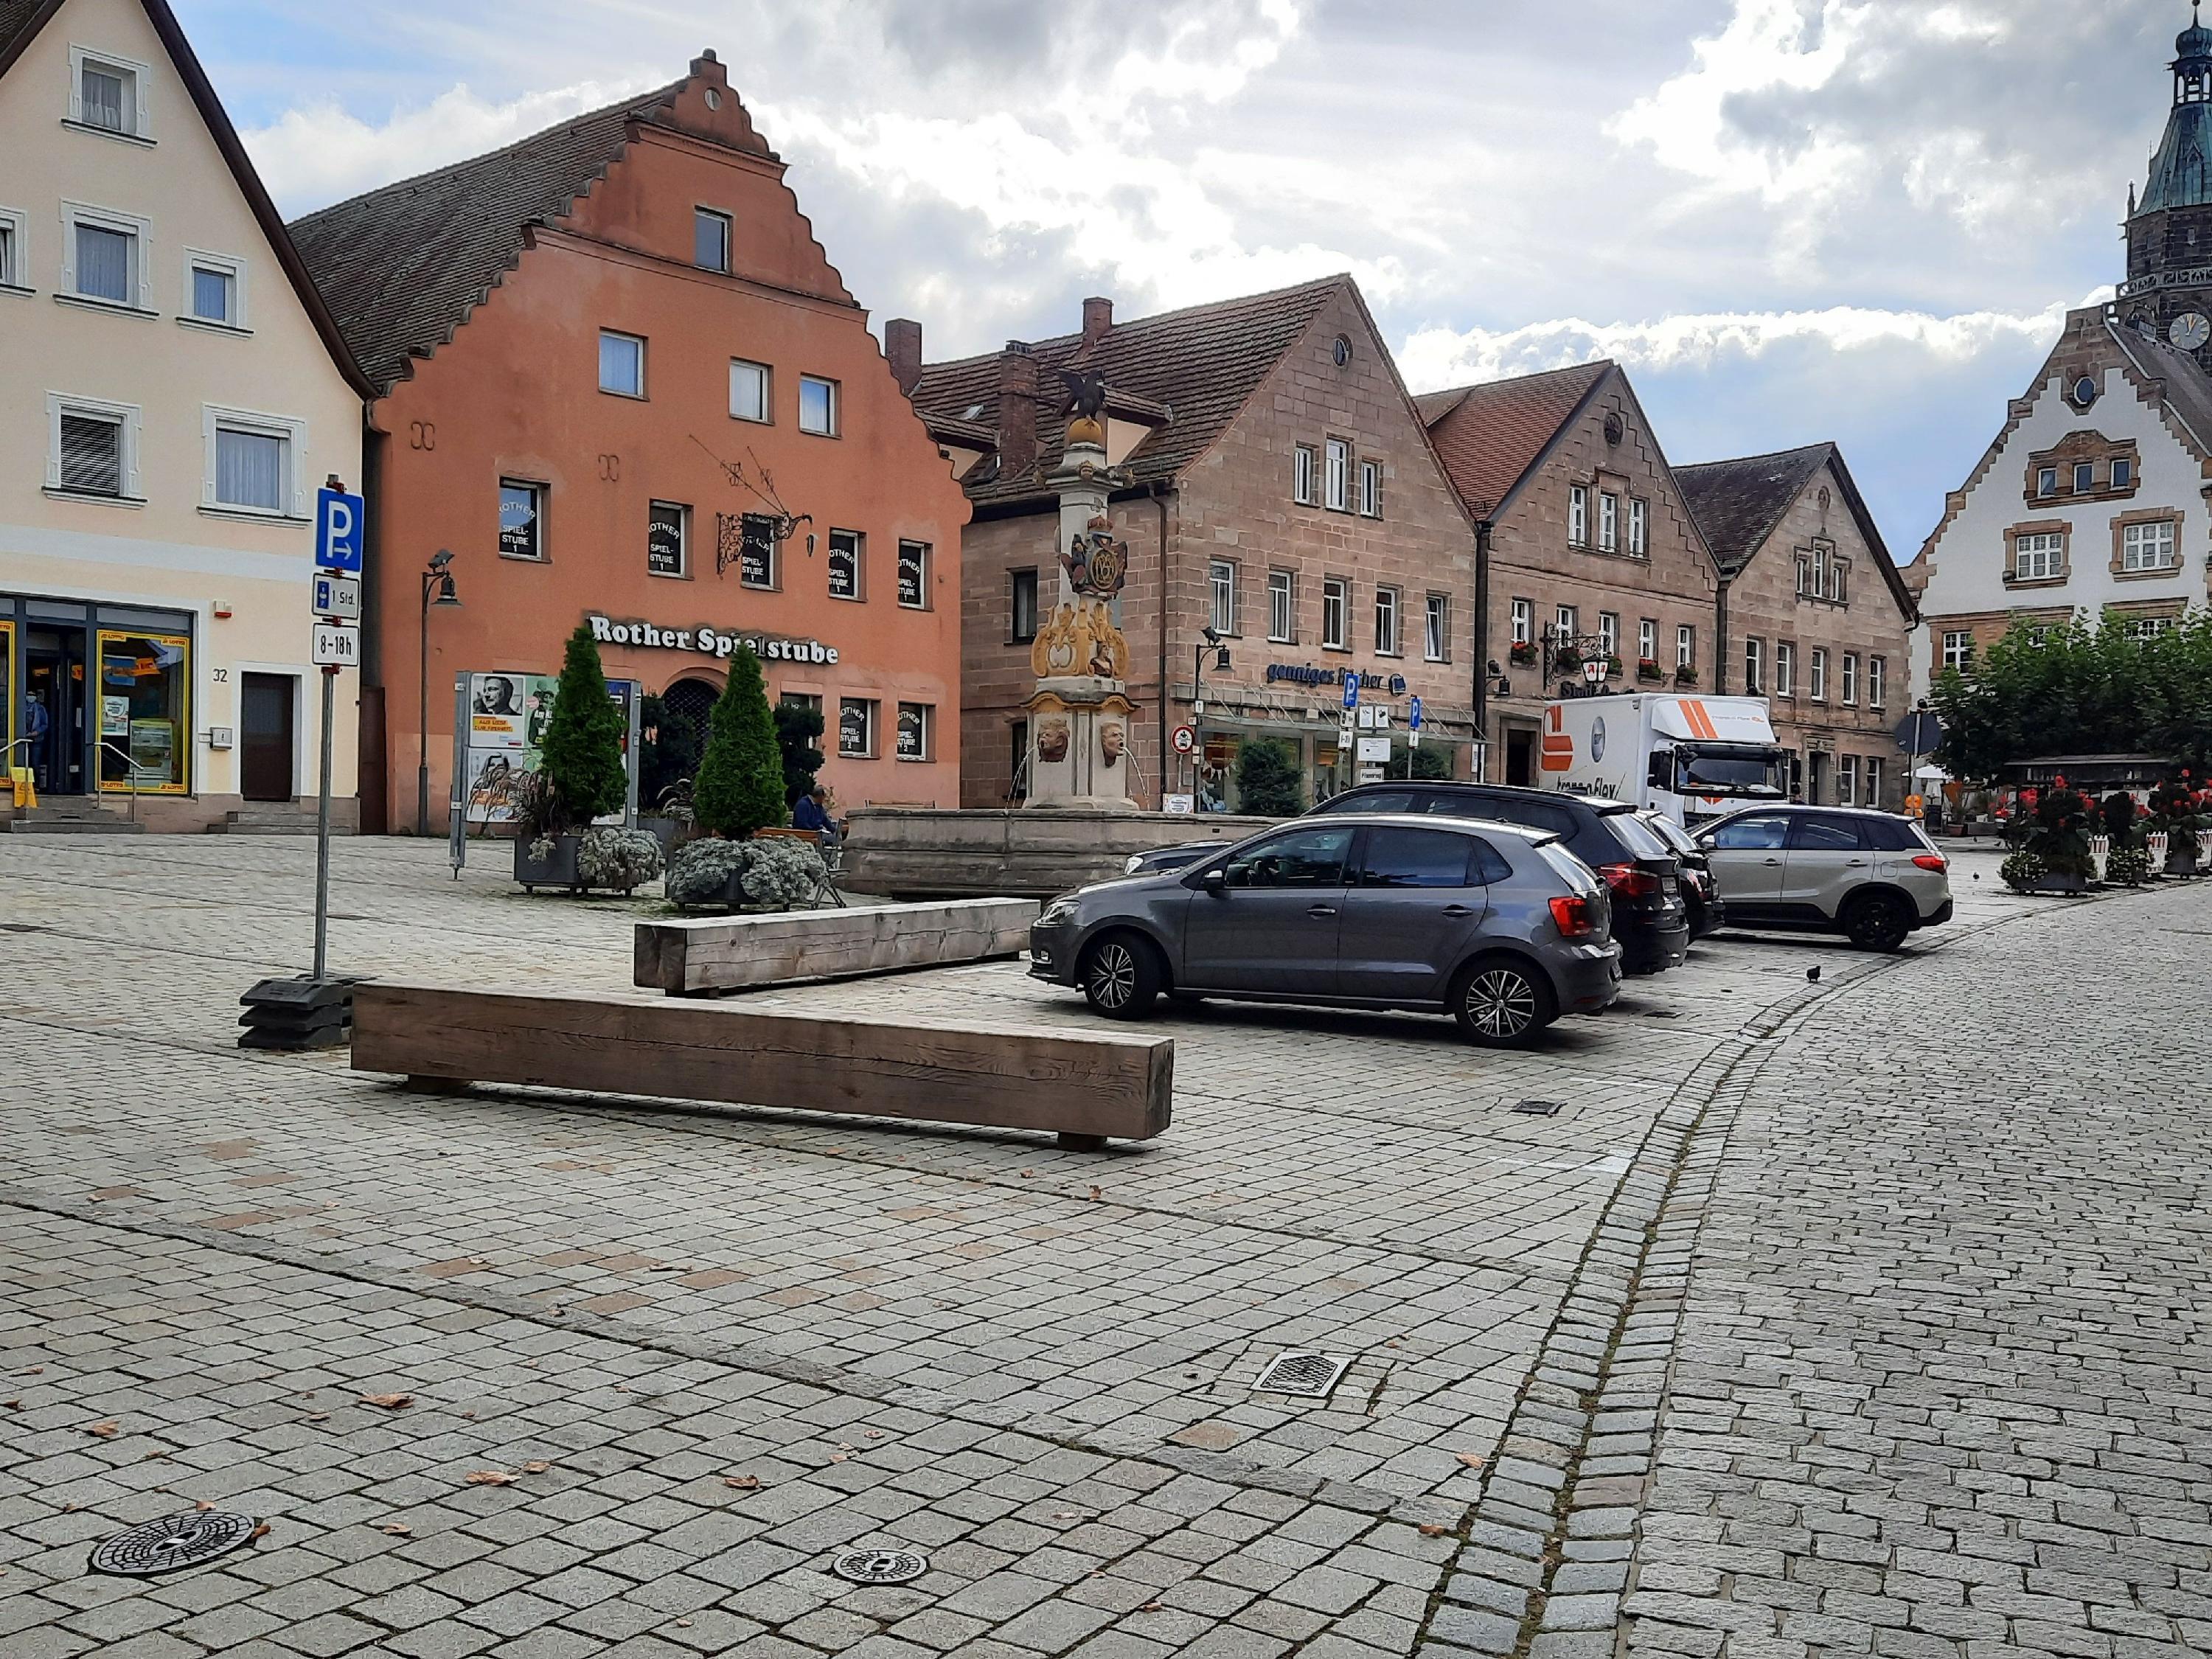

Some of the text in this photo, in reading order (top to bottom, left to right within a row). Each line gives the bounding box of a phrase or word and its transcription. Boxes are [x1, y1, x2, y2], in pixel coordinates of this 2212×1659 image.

[327, 501, 352, 559] P
[503, 525, 529, 535] SPIEL-
[648, 522, 680, 540] OTHER
[502, 535, 529, 545] STUBE
[513, 544, 518, 552] 1
[650, 544, 674, 554] SPIEL-
[650, 554, 674, 564] STUBE
[828, 549, 855, 563] OTHER
[742, 557, 764, 566] SPIEL-
[660, 563, 664, 571] 1
[742, 566, 764, 575] STUBE
[897, 559, 920, 575] OTHER
[829, 568, 848, 577] SPIEL-
[828, 577, 849, 588] STUBE
[897, 587, 915, 596] TUBE
[333, 590, 355, 605] 1 Std.
[590, 616, 691, 648] Rother
[1267, 662, 1335, 687] genniges
[1587, 665, 1595, 674] A
[213, 669, 228, 682] 32
[1346, 678, 1356, 703] P
[897, 711, 920, 725] OTHER
[1412, 702, 1419, 724] P
[841, 727, 859, 735] SPIEL-
[839, 734, 860, 743] STUBE
